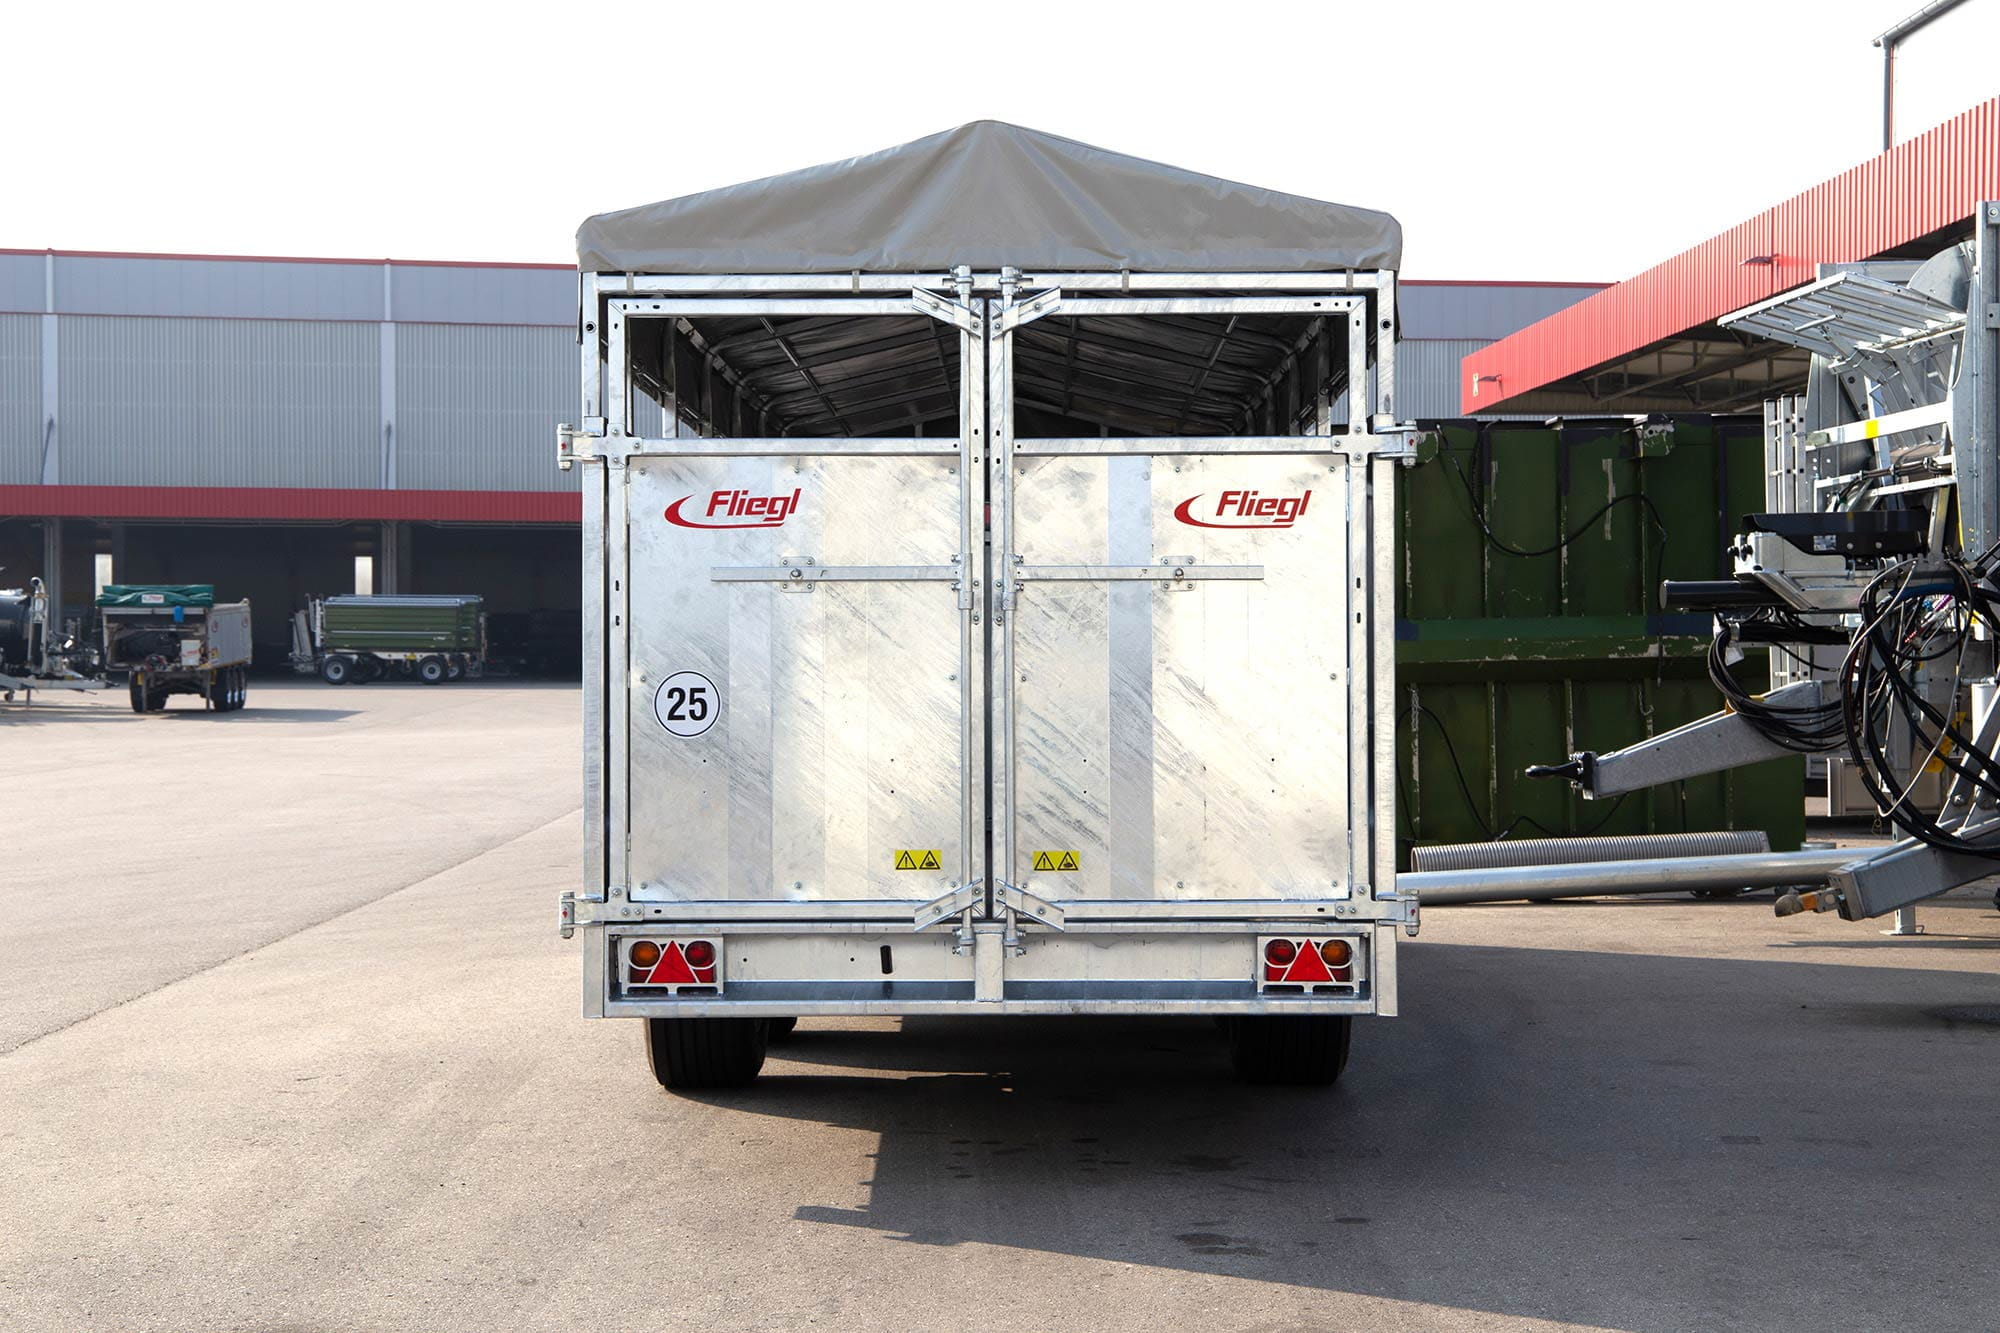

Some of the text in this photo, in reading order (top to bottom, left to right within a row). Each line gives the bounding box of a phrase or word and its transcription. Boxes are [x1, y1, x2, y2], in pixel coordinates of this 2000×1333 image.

[706, 488, 801, 522] Fliegl
[1216, 490, 1312, 523] Fliegl
[667, 687, 708, 721] 25
